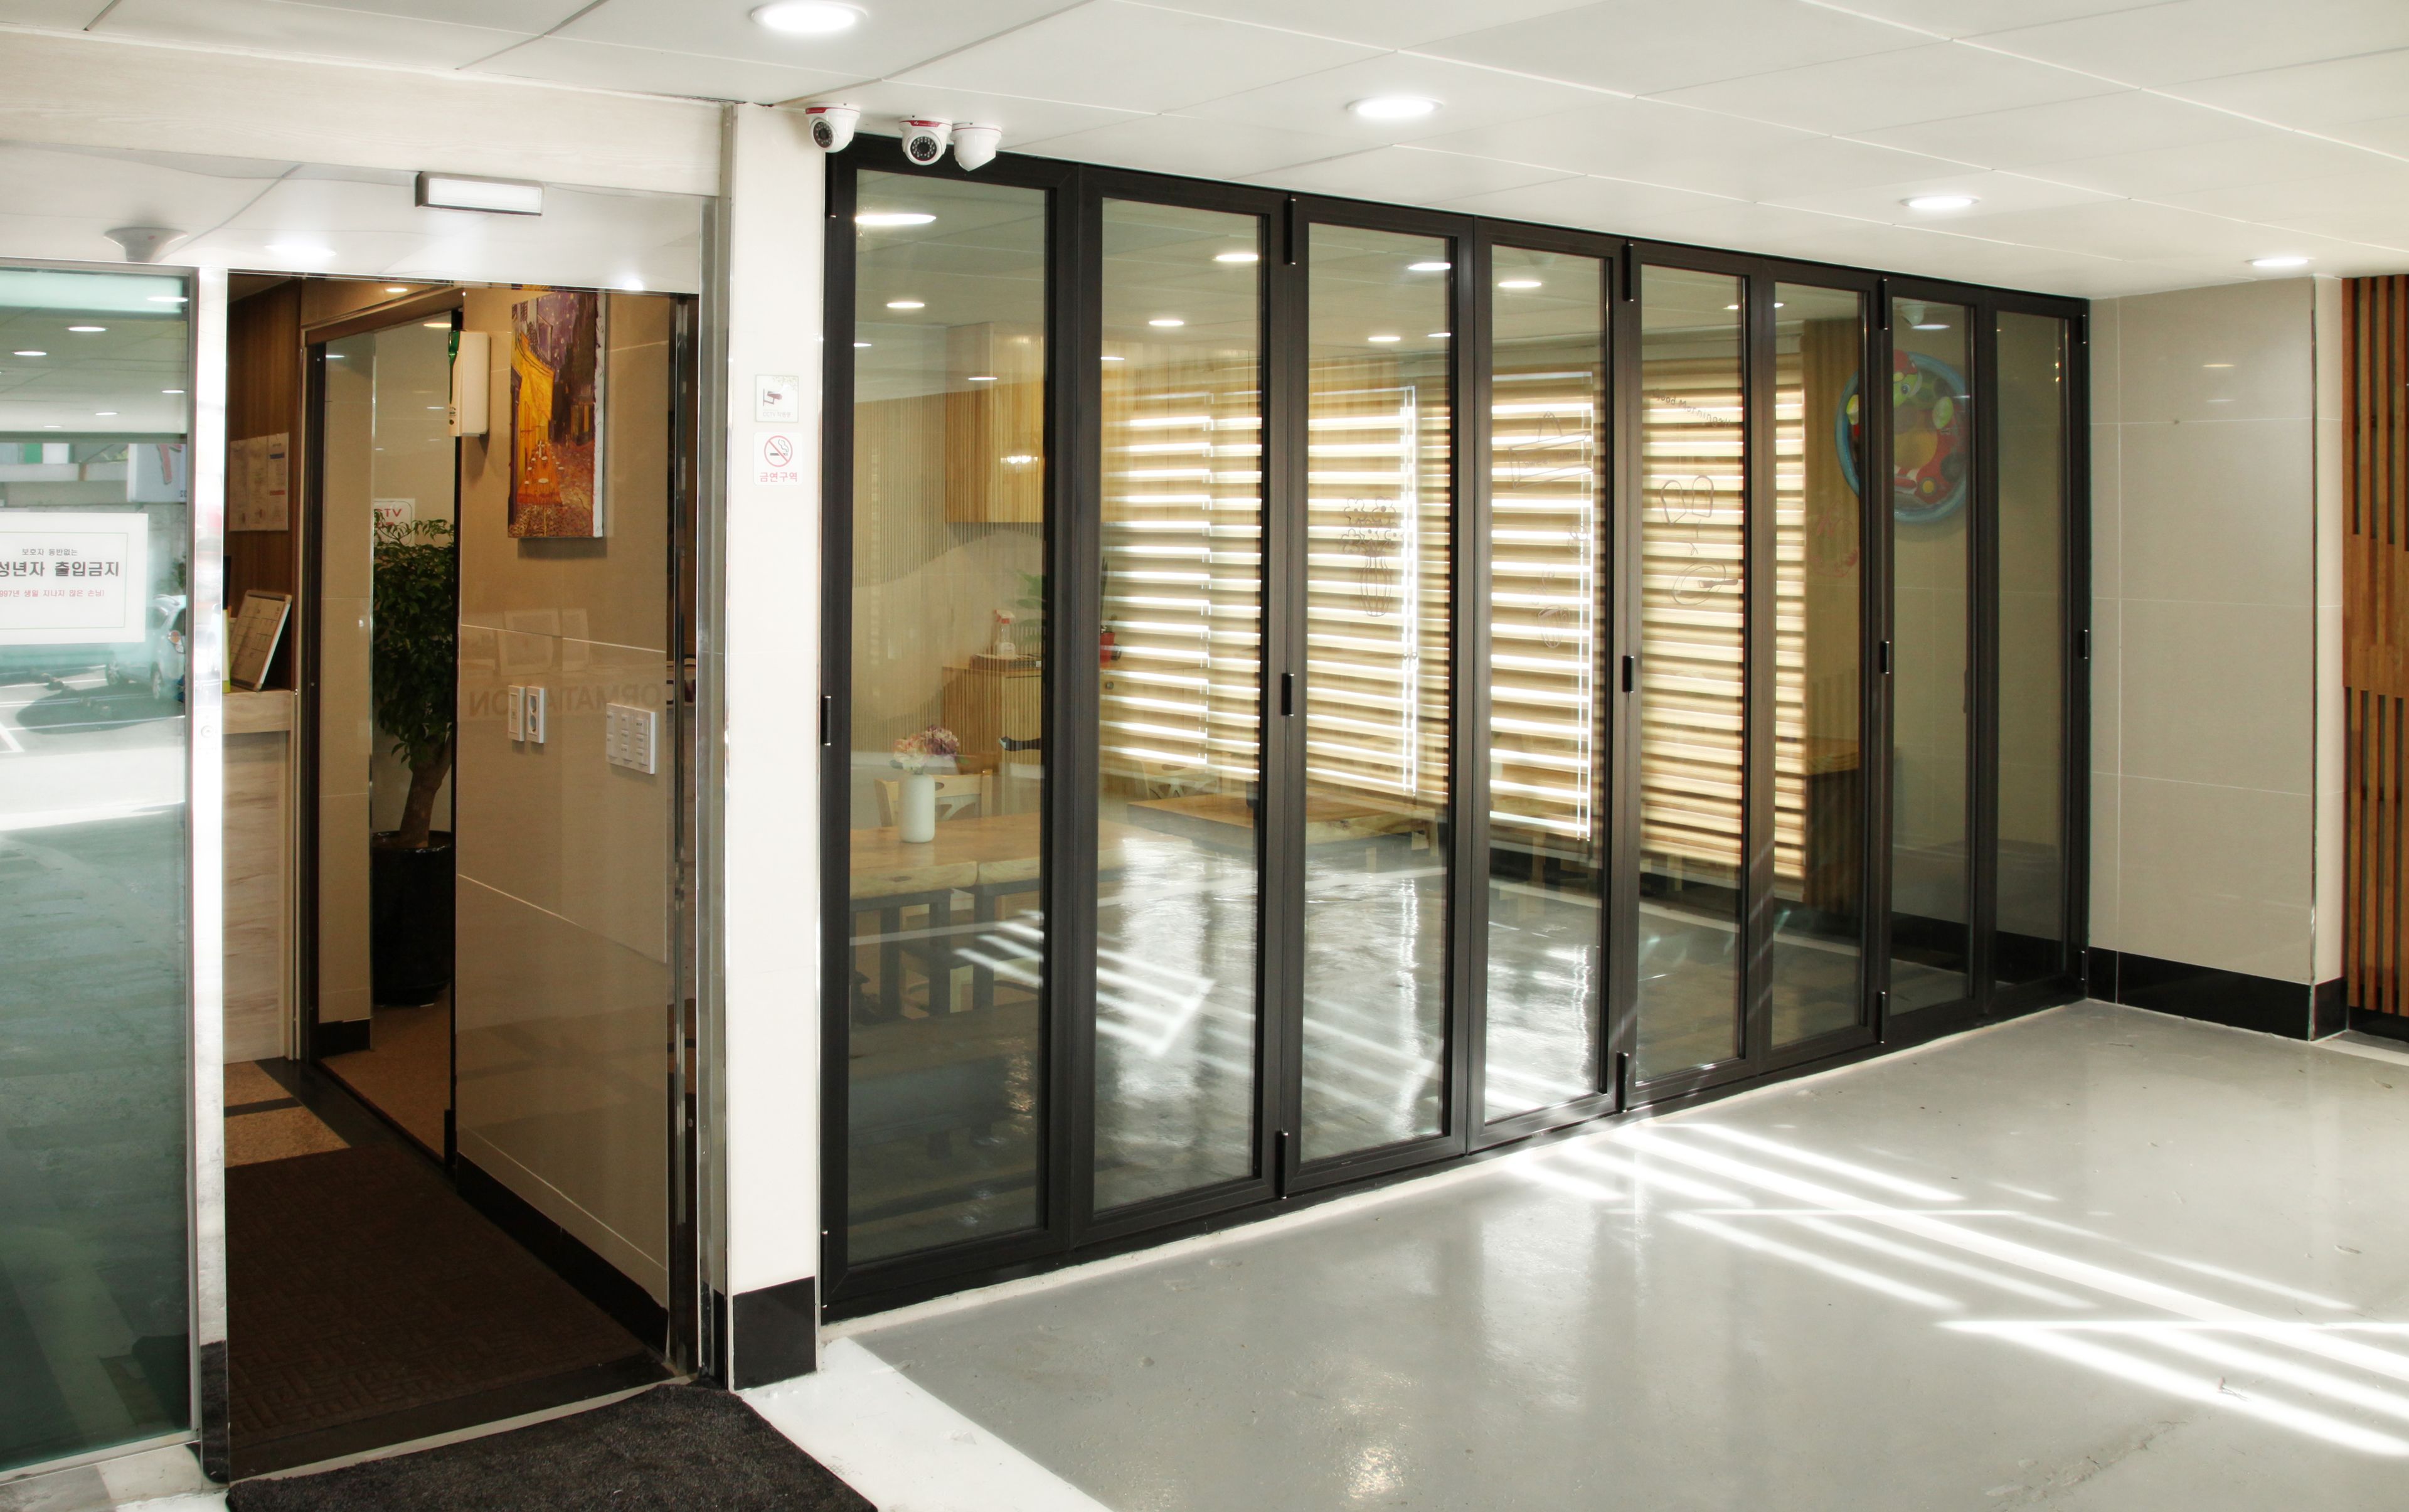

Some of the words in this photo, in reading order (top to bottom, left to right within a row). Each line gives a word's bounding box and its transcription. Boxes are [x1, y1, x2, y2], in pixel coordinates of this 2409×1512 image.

[759, 471, 797, 482] 금연구역
[48, 548, 78, 556] 동반없는
[55, 561, 120, 577] 출입금지
